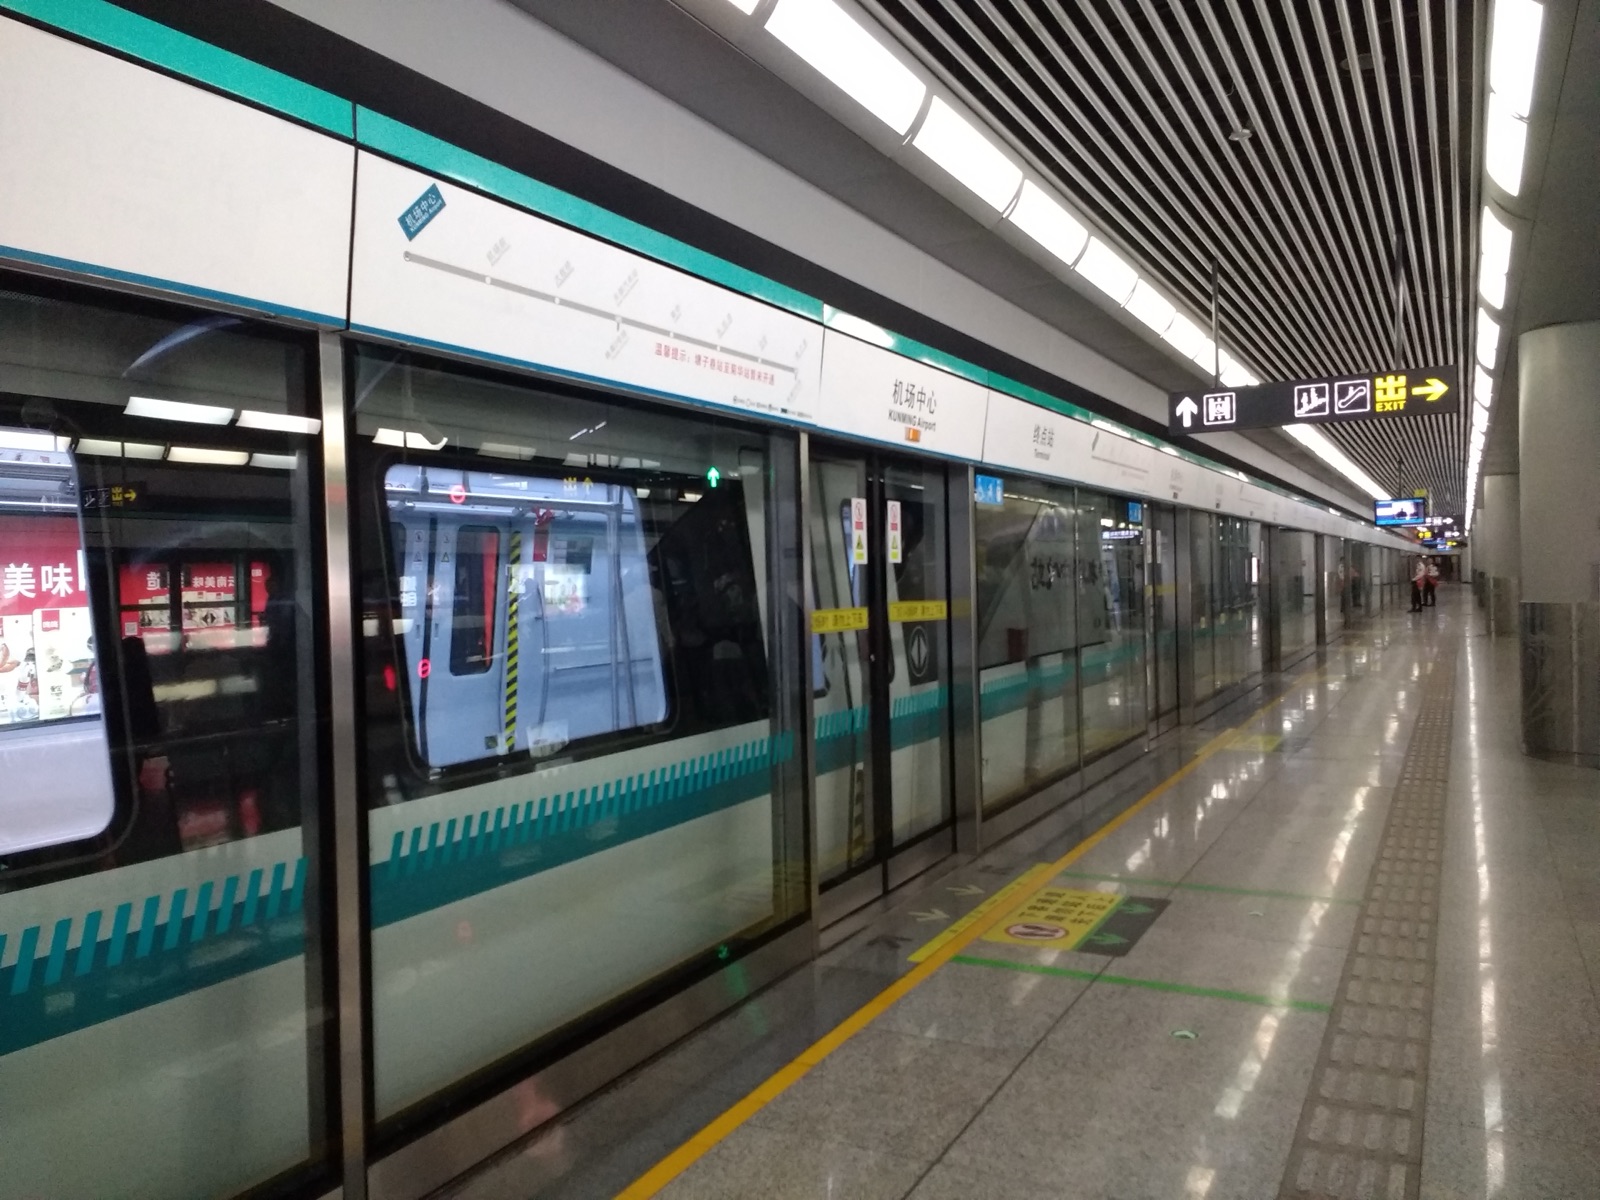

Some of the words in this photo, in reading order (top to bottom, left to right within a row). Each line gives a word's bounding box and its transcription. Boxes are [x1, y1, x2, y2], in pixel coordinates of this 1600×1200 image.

[405, 193, 436, 227] 机场中心
[893, 379, 937, 415] 机场中心
[1376, 375, 1406, 402] 出
[888, 409, 916, 427] KUNMING
[1376, 400, 1406, 412] EXIT
[1033, 424, 1055, 448] 终点站
